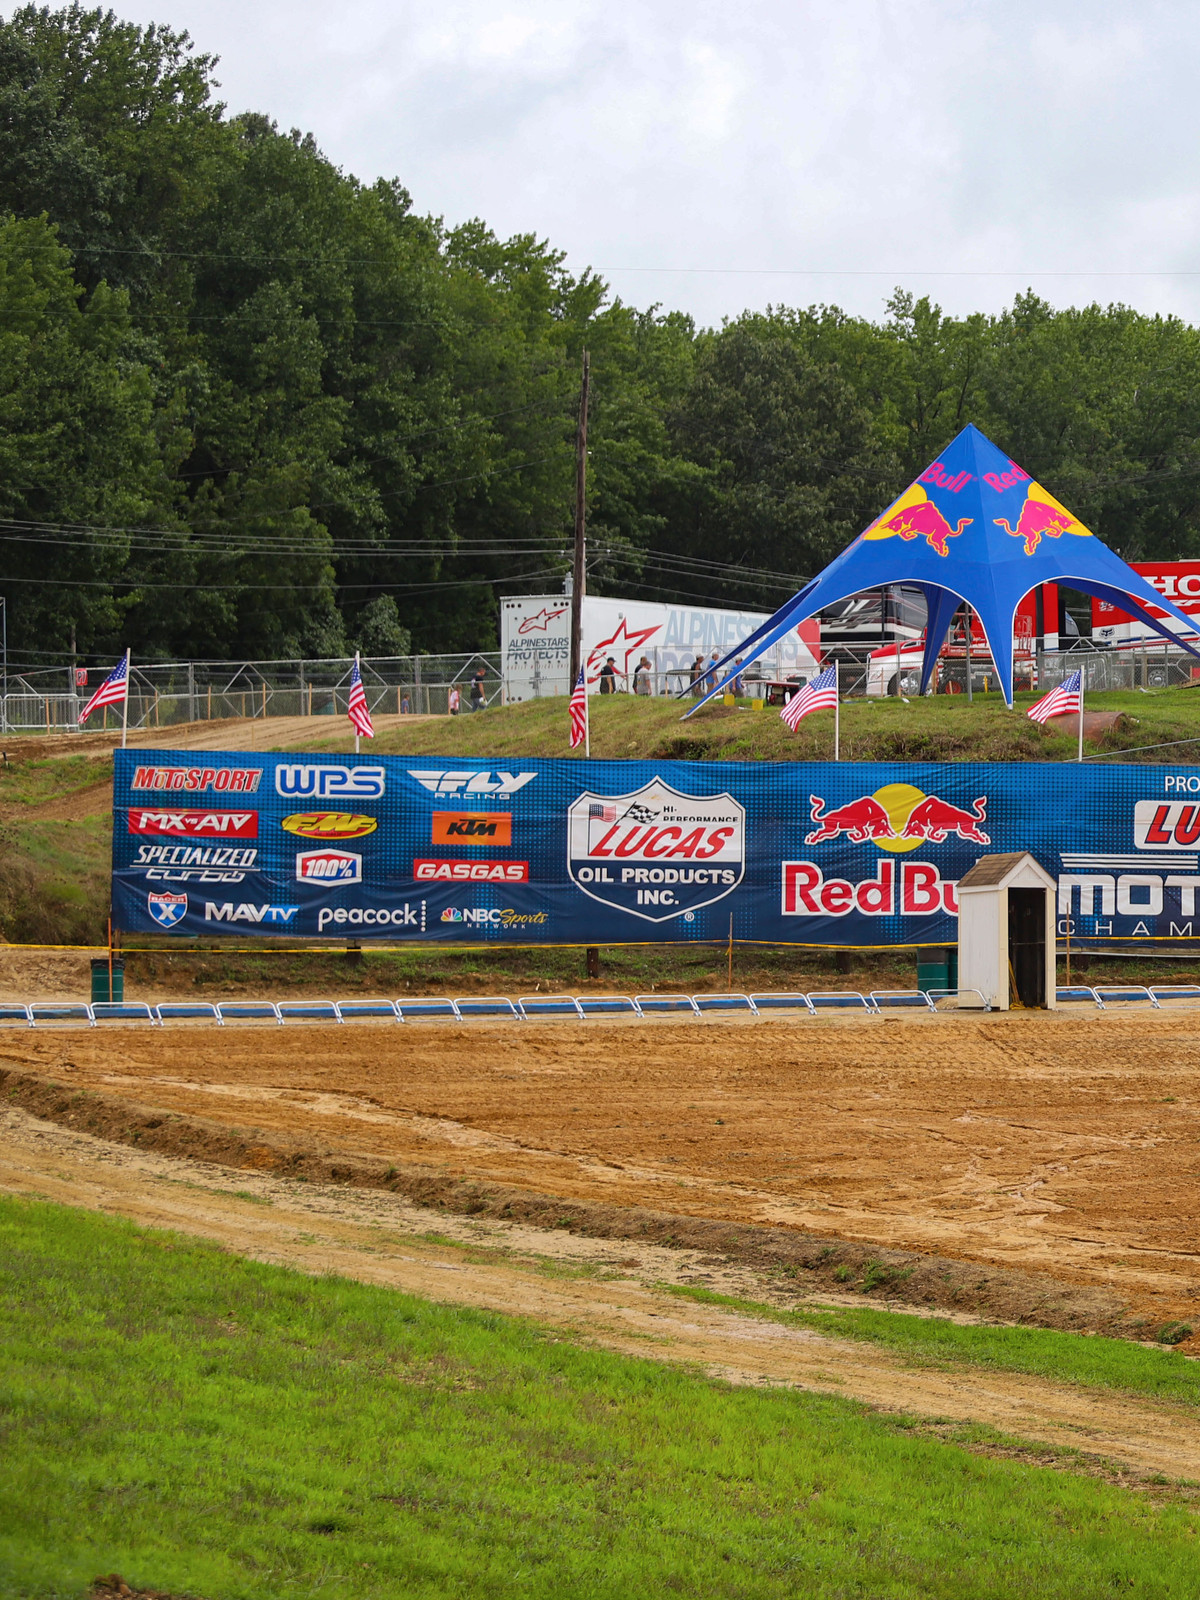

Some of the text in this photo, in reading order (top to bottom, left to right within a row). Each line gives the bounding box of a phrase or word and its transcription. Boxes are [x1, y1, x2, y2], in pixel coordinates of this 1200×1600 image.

[921, 461, 973, 493] Bull
[982, 459, 1031, 493] Red
[509, 637, 569, 648] ALPINESTARS
[278, 766, 383, 798] WPS
[408, 770, 538, 793] FLY
[434, 792, 510, 800] RACING
[139, 812, 186, 830] MX
[194, 814, 253, 831] ATV
[283, 815, 377, 831] FMF
[446, 819, 497, 836] KTM
[588, 825, 735, 859] LUCAS
[133, 845, 258, 867] SPECIALIZED
[146, 868, 246, 883] turbo
[305, 859, 353, 877] 100%
[416, 863, 524, 880] GASGAS
[578, 868, 735, 884] OIL PRODUCTS
[783, 860, 958, 916] Red Bu
[637, 890, 679, 905] INC.
[158, 903, 177, 921] X
[205, 902, 299, 921] MAVTV
[318, 903, 418, 932] peacock
[463, 908, 548, 924] NBC Sports
